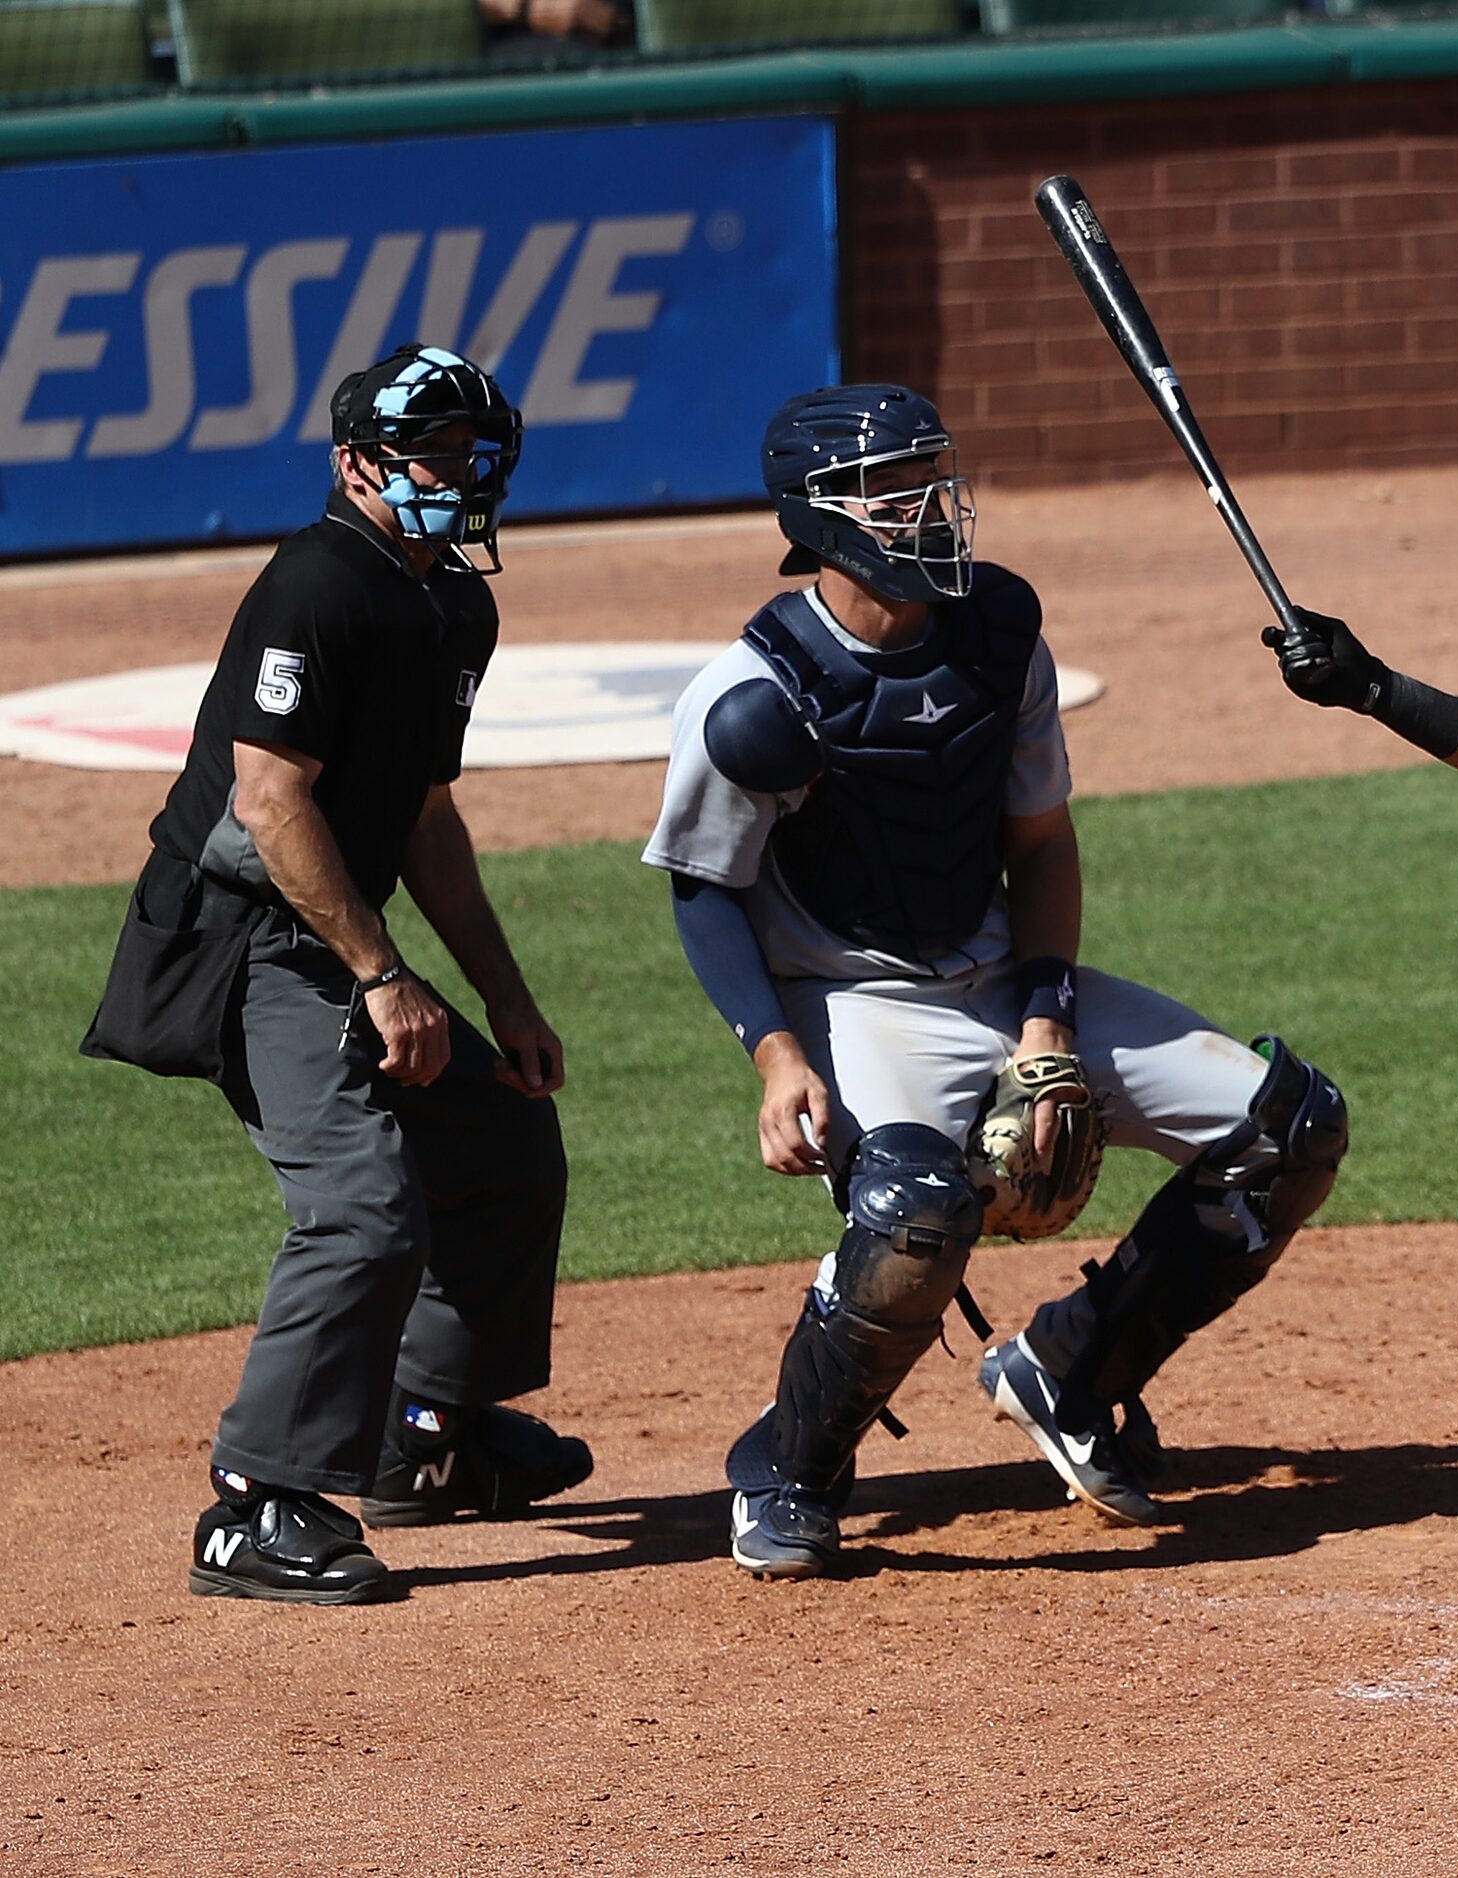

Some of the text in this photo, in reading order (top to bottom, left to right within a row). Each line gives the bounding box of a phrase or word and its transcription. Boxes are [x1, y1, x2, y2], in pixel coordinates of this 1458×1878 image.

[254, 647, 306, 715] 5
[413, 1450, 456, 1491] N
[203, 1528, 244, 1567] N
